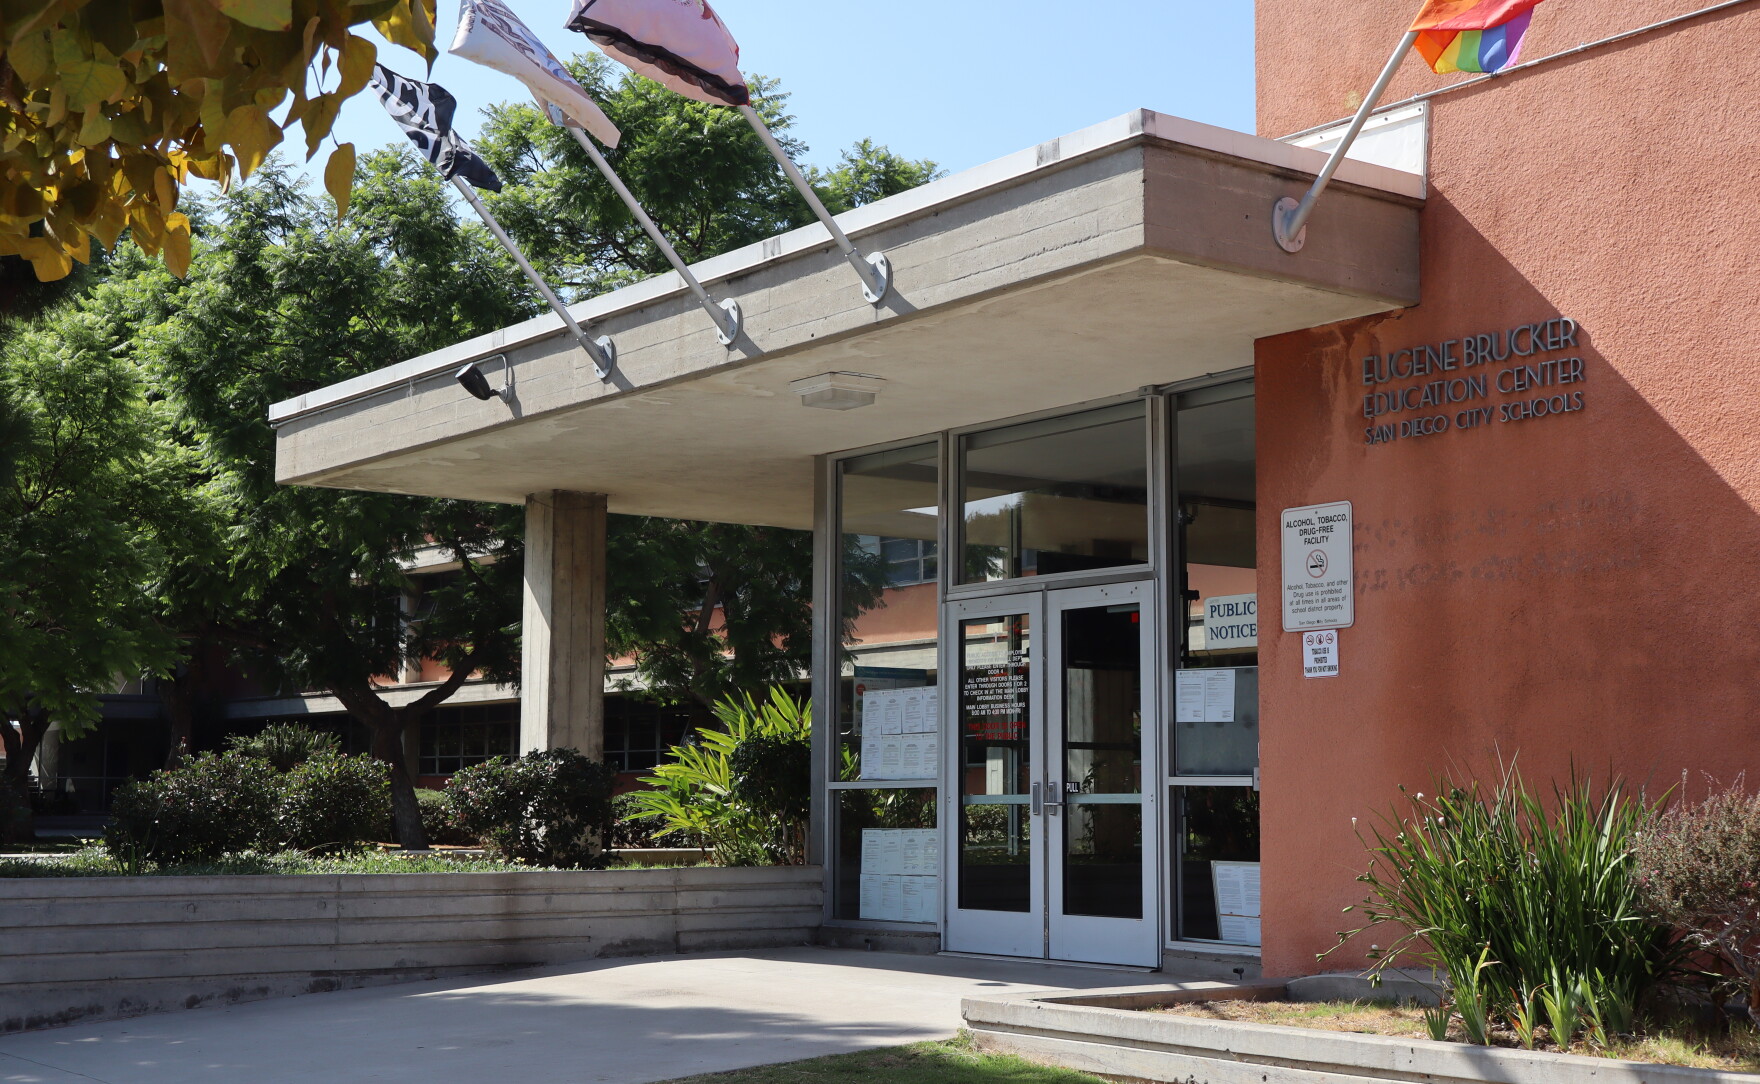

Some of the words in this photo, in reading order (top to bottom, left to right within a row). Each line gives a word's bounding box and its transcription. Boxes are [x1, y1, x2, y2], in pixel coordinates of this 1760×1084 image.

[1362, 340, 1458, 385] EUGENE
[1464, 317, 1578, 366] BRUCKER
[1364, 374, 1487, 418] EDUCATION
[1496, 358, 1585, 393] CENTER
[1364, 423, 1396, 444] SAN
[1401, 415, 1448, 438] DIEGO
[1456, 406, 1494, 428] CITY
[1500, 392, 1584, 422] SCHOOLS
[1318, 514, 1348, 524] TOBACCO,
[1299, 525, 1334, 536] DRUG-FREE
[1304, 536, 1329, 545] FACILITY
[1210, 601, 1256, 618] PUBLIC
[1210, 624, 1257, 640] NOTICE
[1067, 782, 1078, 792] PULL
